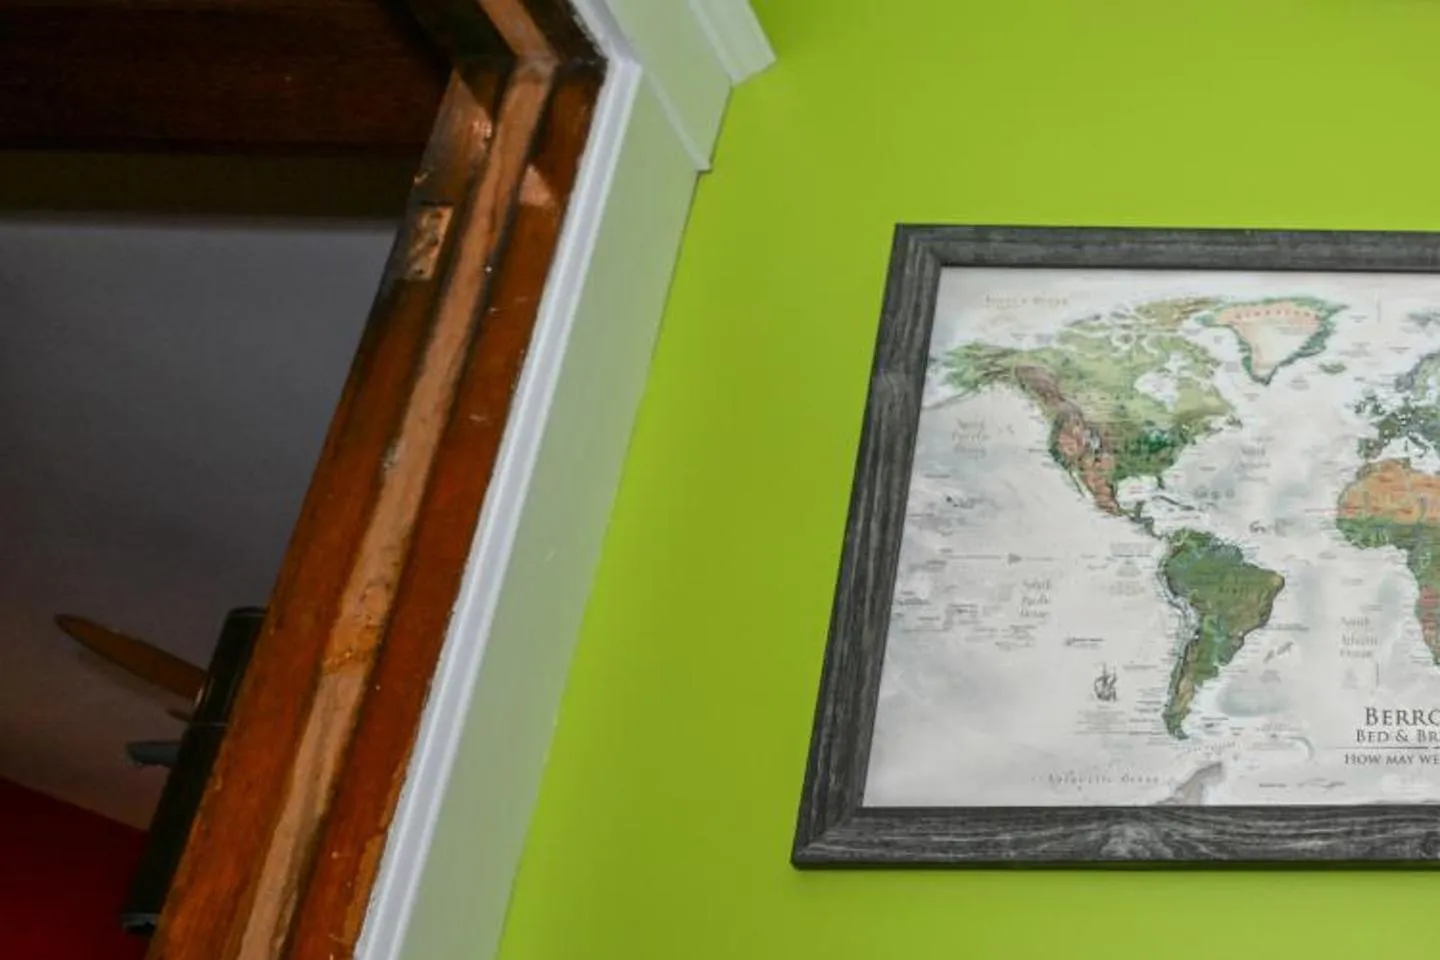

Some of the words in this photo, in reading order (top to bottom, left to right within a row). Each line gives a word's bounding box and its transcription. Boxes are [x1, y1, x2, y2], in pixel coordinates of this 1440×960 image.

[1395, 730, 1408, 743] &
[1343, 753, 1381, 766] HOW
[1385, 754, 1415, 766] MAY
[1420, 754, 1440, 766] WE
